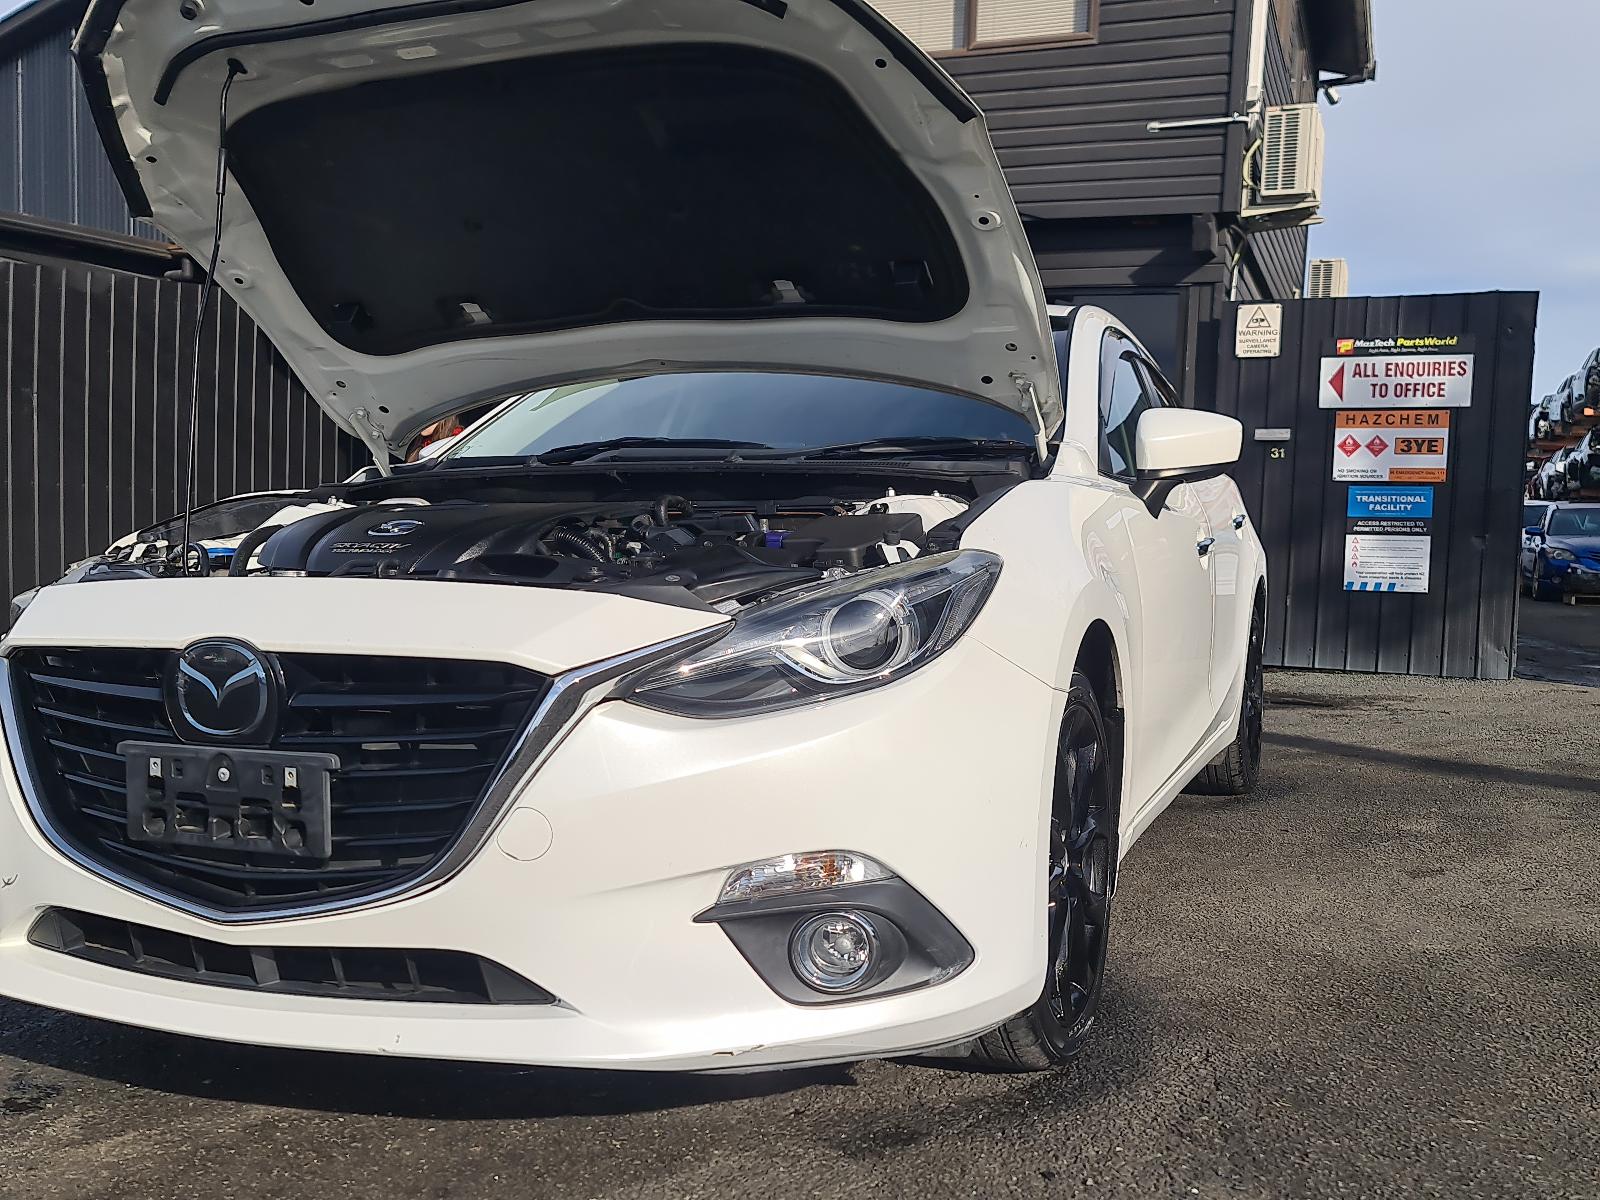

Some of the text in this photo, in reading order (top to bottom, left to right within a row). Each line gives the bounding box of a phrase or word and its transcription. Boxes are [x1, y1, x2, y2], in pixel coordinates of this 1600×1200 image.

[1397, 335, 1458, 347] PartsWorld
[1352, 361, 1467, 378] ALL ENQUIRIES
[1370, 382, 1446, 398] TO OFFICE
[1345, 413, 1440, 426] HAZCHEM
[1400, 439, 1439, 453] 3YE
[1270, 447, 1285, 458] 31
[1355, 495, 1427, 503] TRANSITIONAL
[1368, 503, 1413, 511] FACILITY
